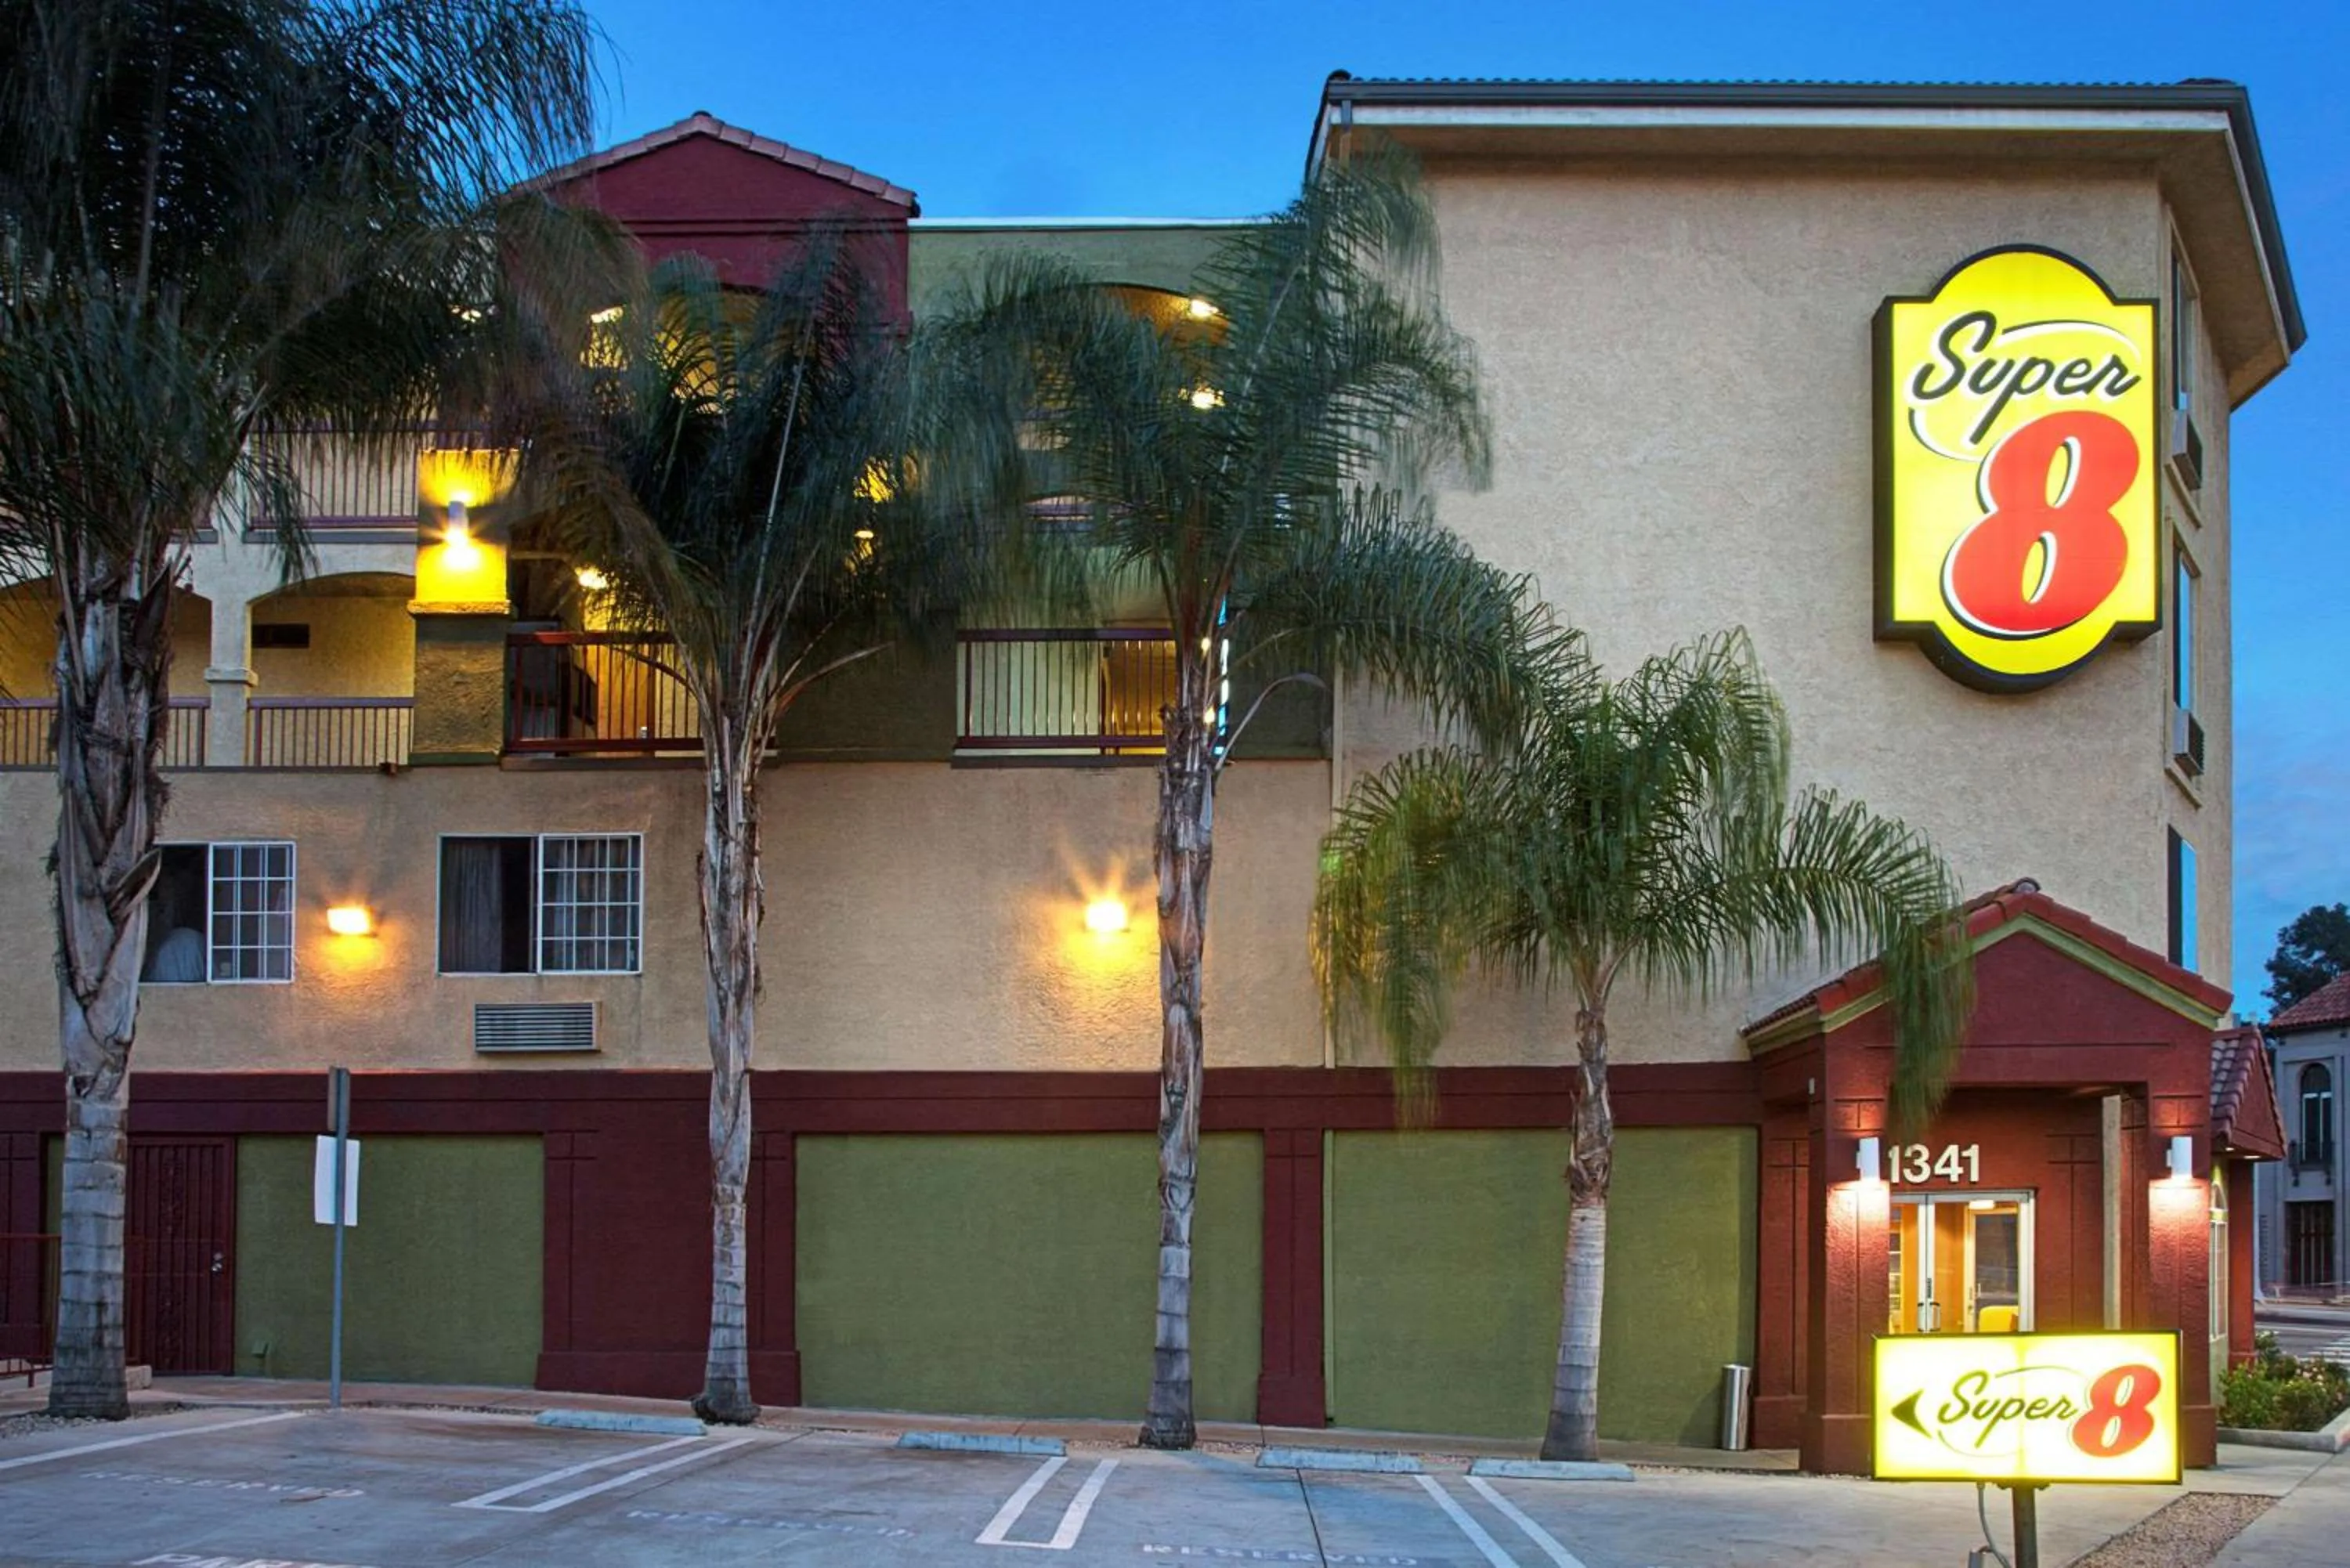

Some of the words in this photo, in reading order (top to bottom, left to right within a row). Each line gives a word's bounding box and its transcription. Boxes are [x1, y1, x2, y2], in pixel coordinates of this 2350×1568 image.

[1911, 309, 2141, 446] Super
[1942, 410, 2140, 638] 8
[1888, 1143, 1979, 1183] 1341
[1937, 1370, 2080, 1449] Super
[2070, 1364, 2161, 1458] 8
